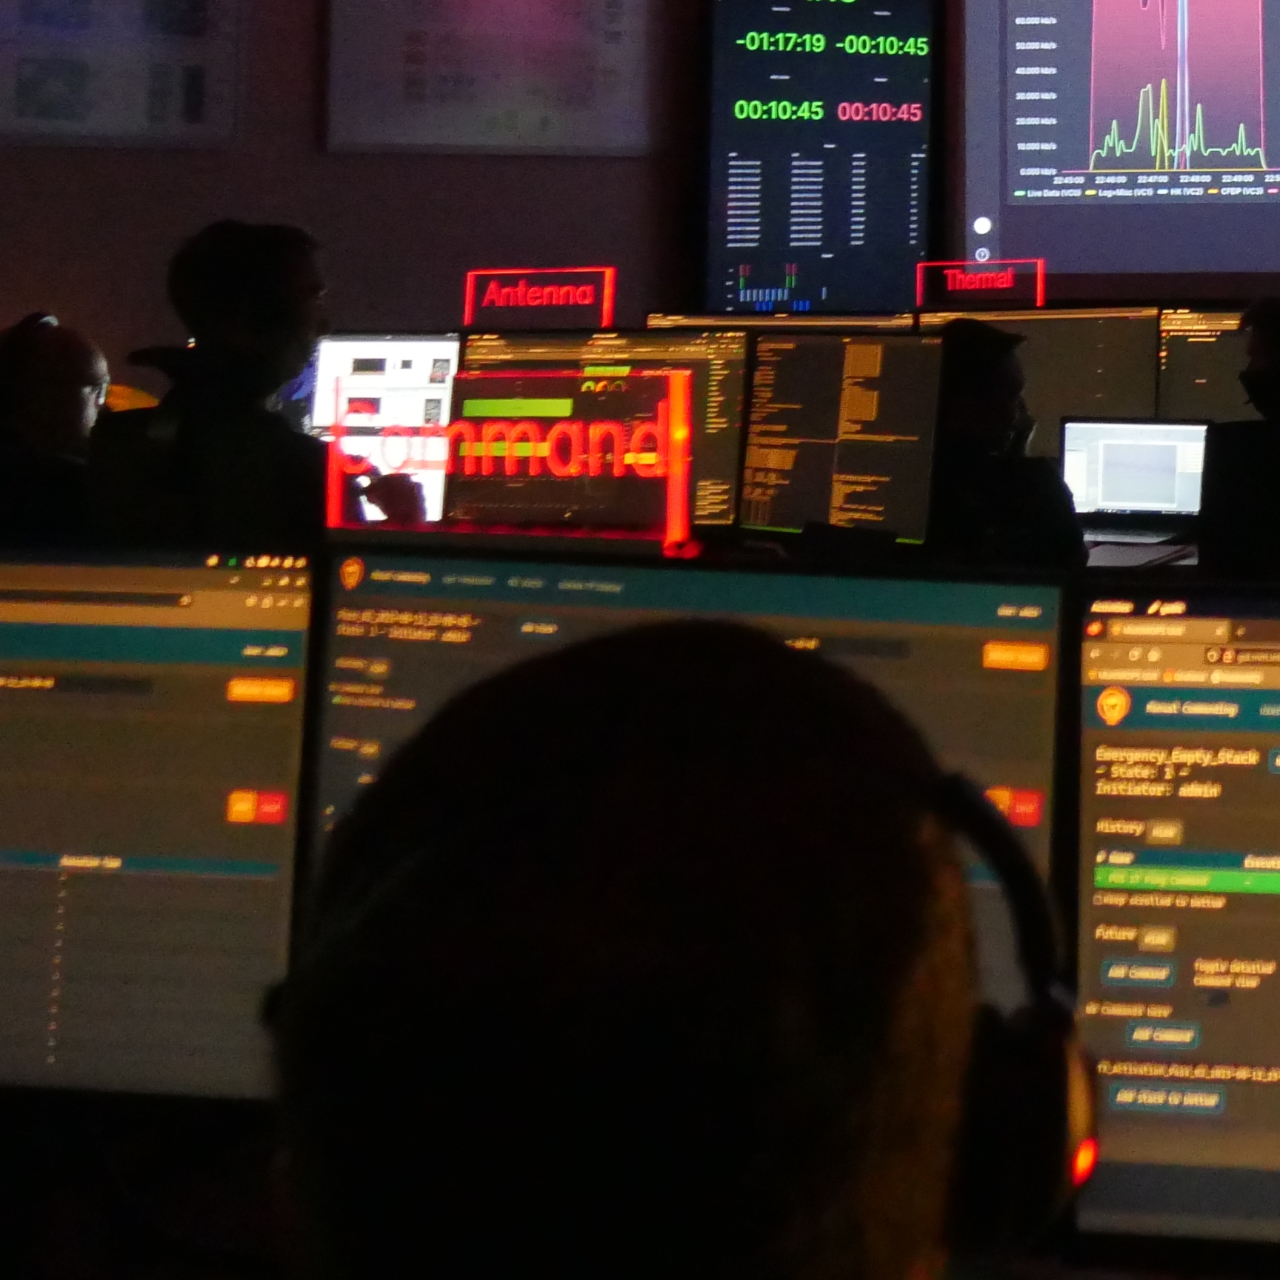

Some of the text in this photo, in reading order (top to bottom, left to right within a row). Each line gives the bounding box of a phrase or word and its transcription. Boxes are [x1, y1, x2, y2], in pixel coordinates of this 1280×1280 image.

[736, 32, 928, 55] -01:17:19 -00:10:45
[734, 100, 922, 121] 00:10:45 00:10:45
[944, 267, 1014, 291] Thermal
[482, 279, 594, 308] Antenna
[1097, 746, 1260, 766] Emergency_Empty_Stack
[1097, 782, 1222, 798] Initiator: admin
[1097, 821, 1144, 836] History
[1096, 927, 1137, 940] Future
